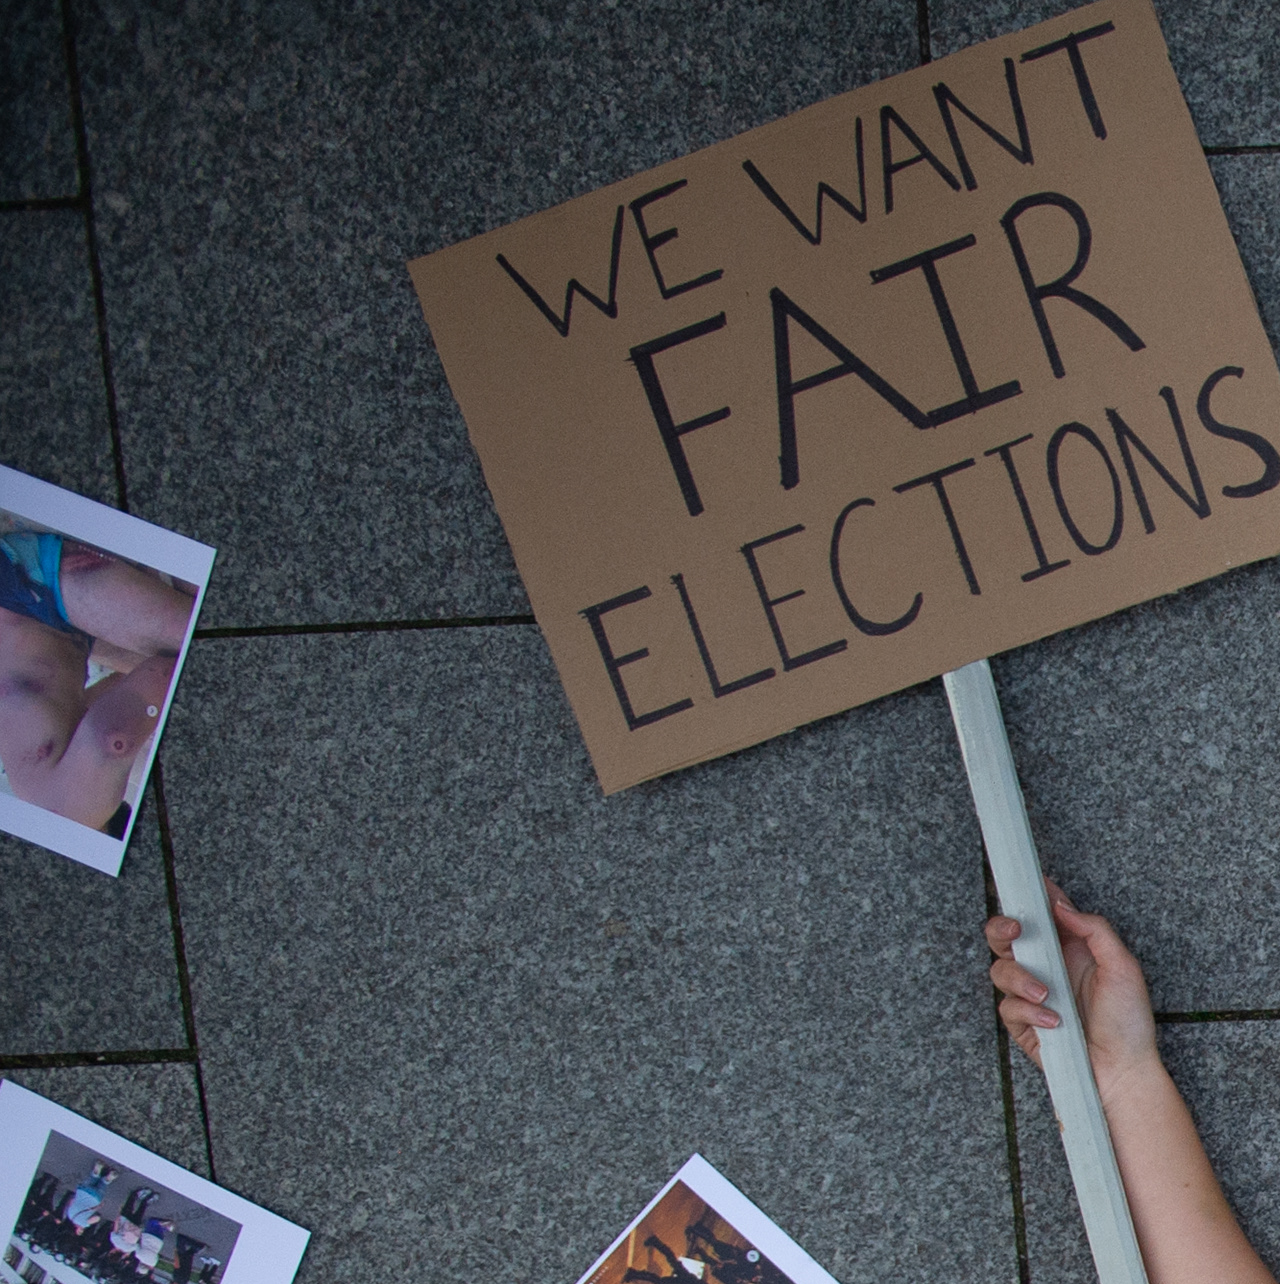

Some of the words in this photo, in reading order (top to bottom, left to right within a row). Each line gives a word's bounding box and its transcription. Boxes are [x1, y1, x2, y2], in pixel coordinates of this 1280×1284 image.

[495, 180, 724, 337] WE
[742, 20, 1116, 246] WANT
[627, 191, 1147, 517] FAIR
